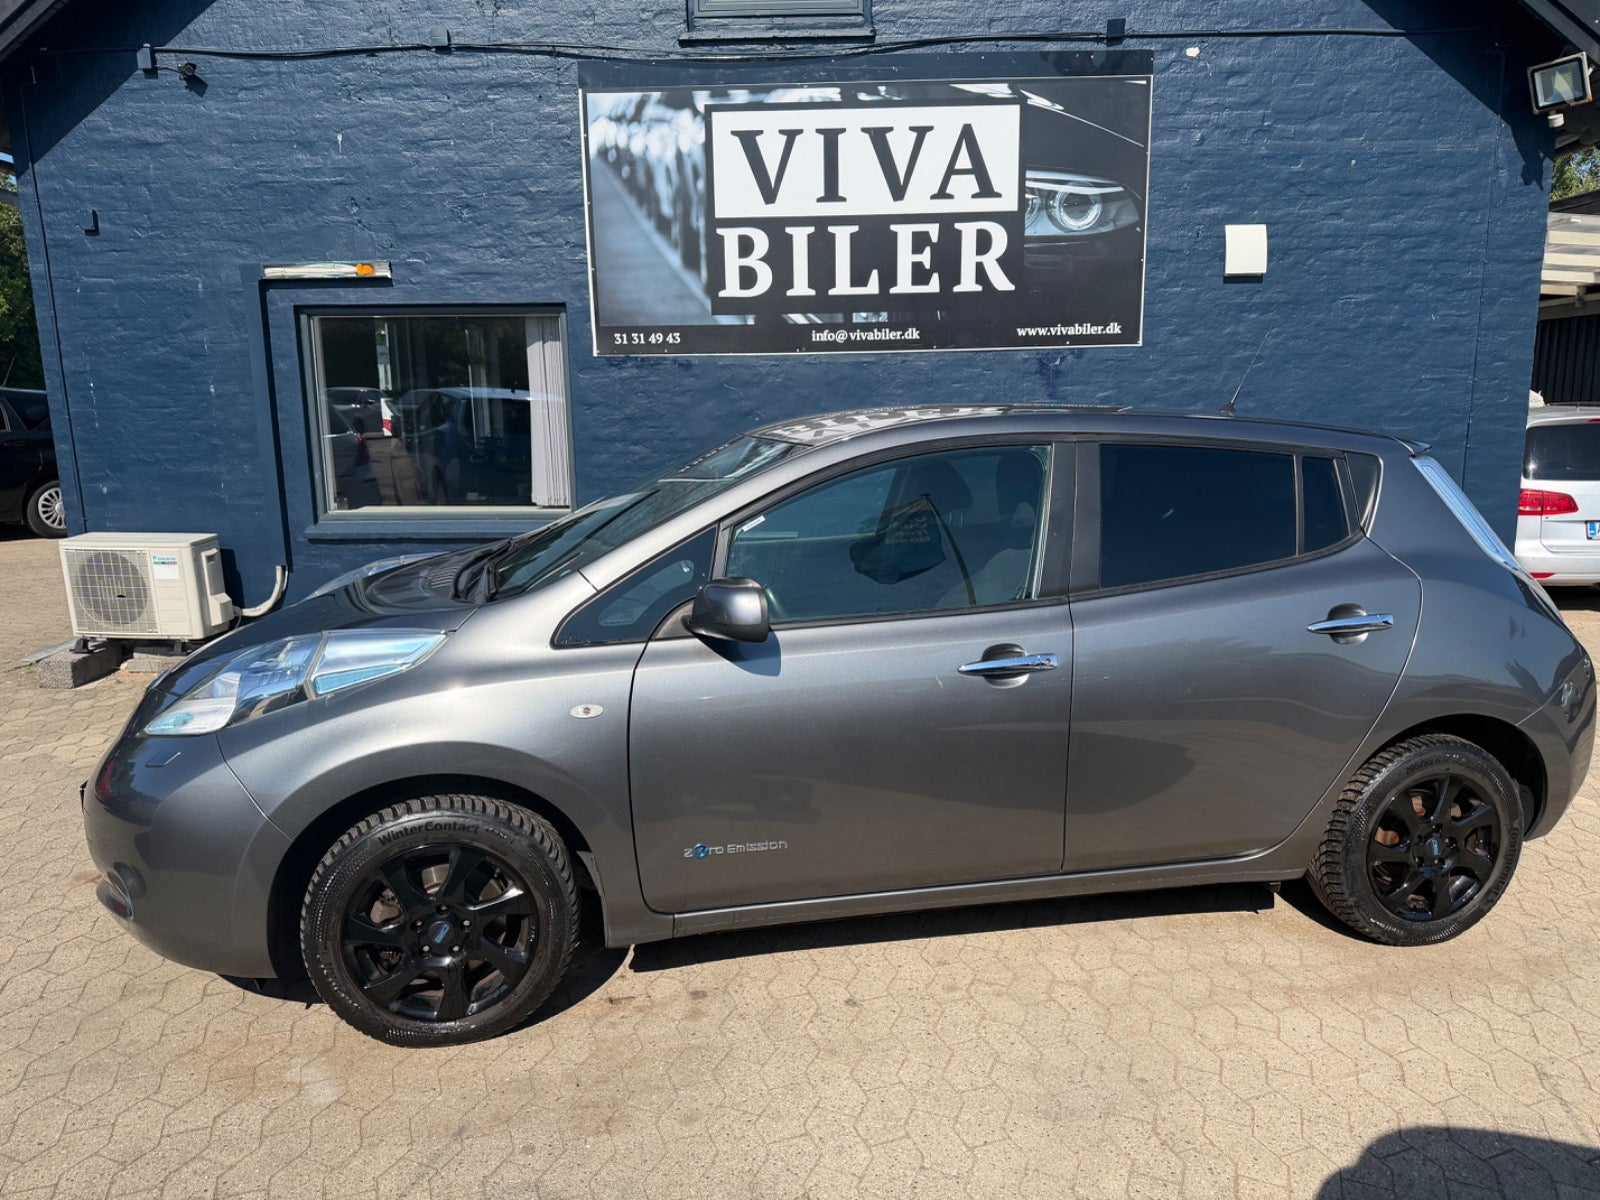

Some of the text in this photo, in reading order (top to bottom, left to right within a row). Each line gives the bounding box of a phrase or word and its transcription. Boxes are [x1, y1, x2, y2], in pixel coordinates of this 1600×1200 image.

[730, 123, 1003, 205] VIVA
[716, 220, 1015, 299] BILER
[614, 332, 681, 344] 31 31 49 43
[1016, 322, 1122, 336] www.vivabiler.dk
[377, 821, 479, 846] WinterContact
[727, 840, 788, 854] Emission
